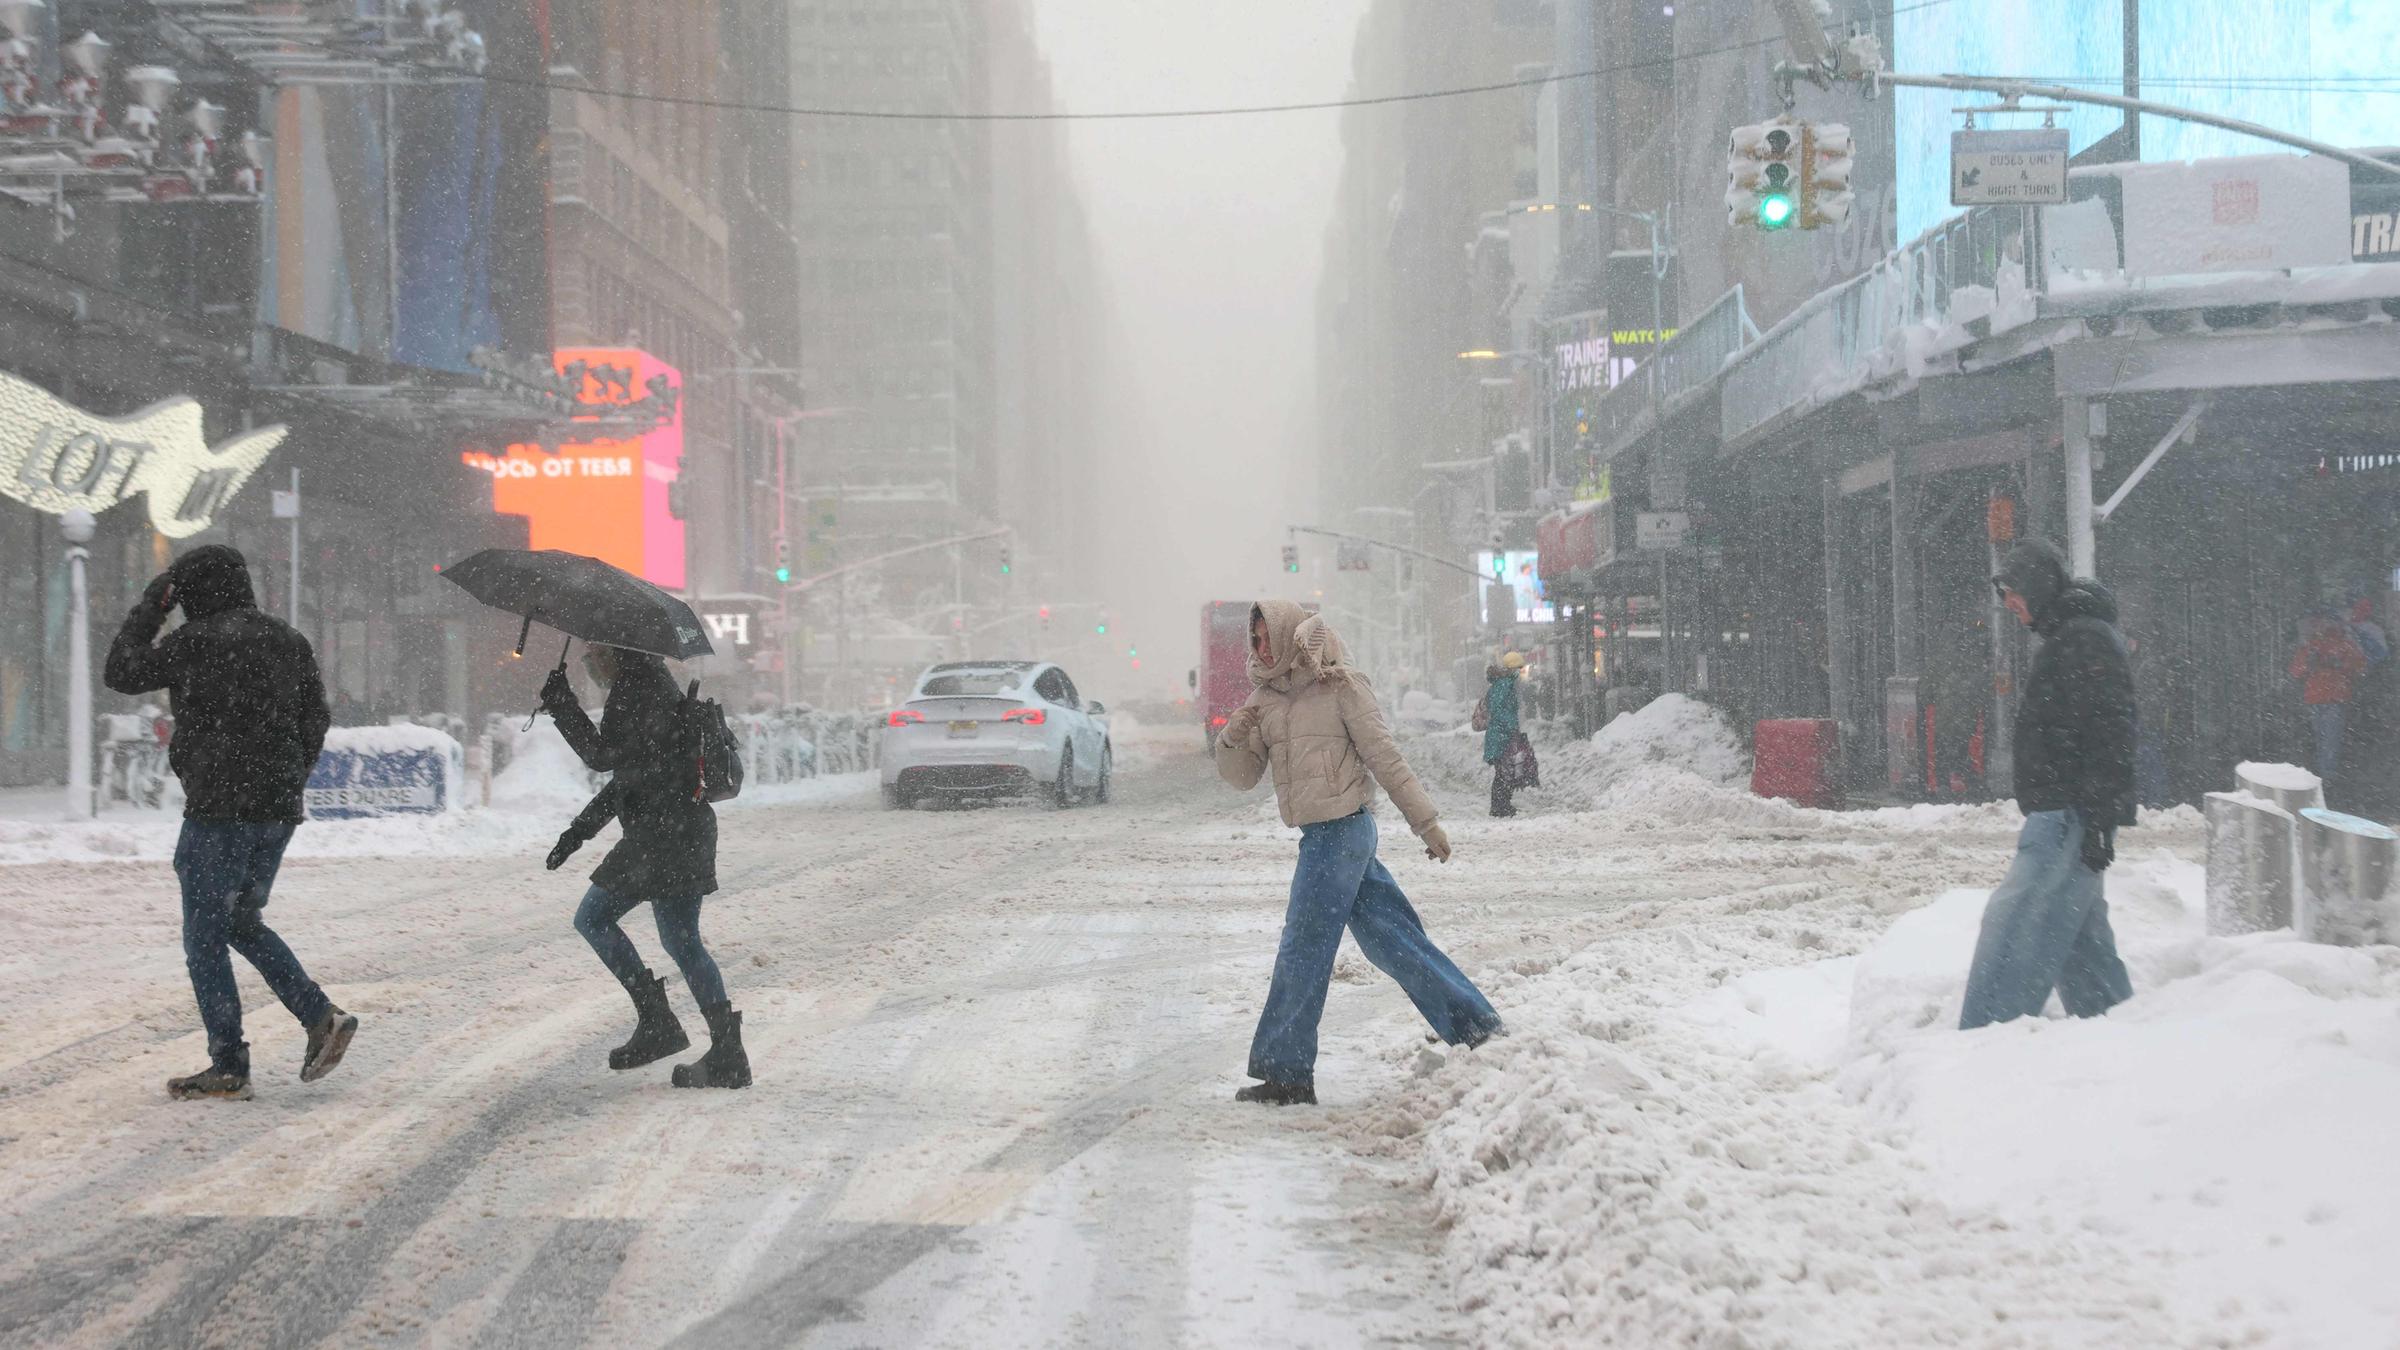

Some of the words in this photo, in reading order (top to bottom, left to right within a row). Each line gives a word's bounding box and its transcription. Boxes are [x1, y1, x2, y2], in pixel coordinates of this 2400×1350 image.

[1989, 154, 2025, 166] BUSES
[2029, 153, 2057, 165] ONLY
[1987, 185, 2017, 197] RIGHT
[2022, 184, 2058, 196] TURNS
[542, 457, 573, 477] ОТ
[579, 458, 632, 477] ТЕБЯ
